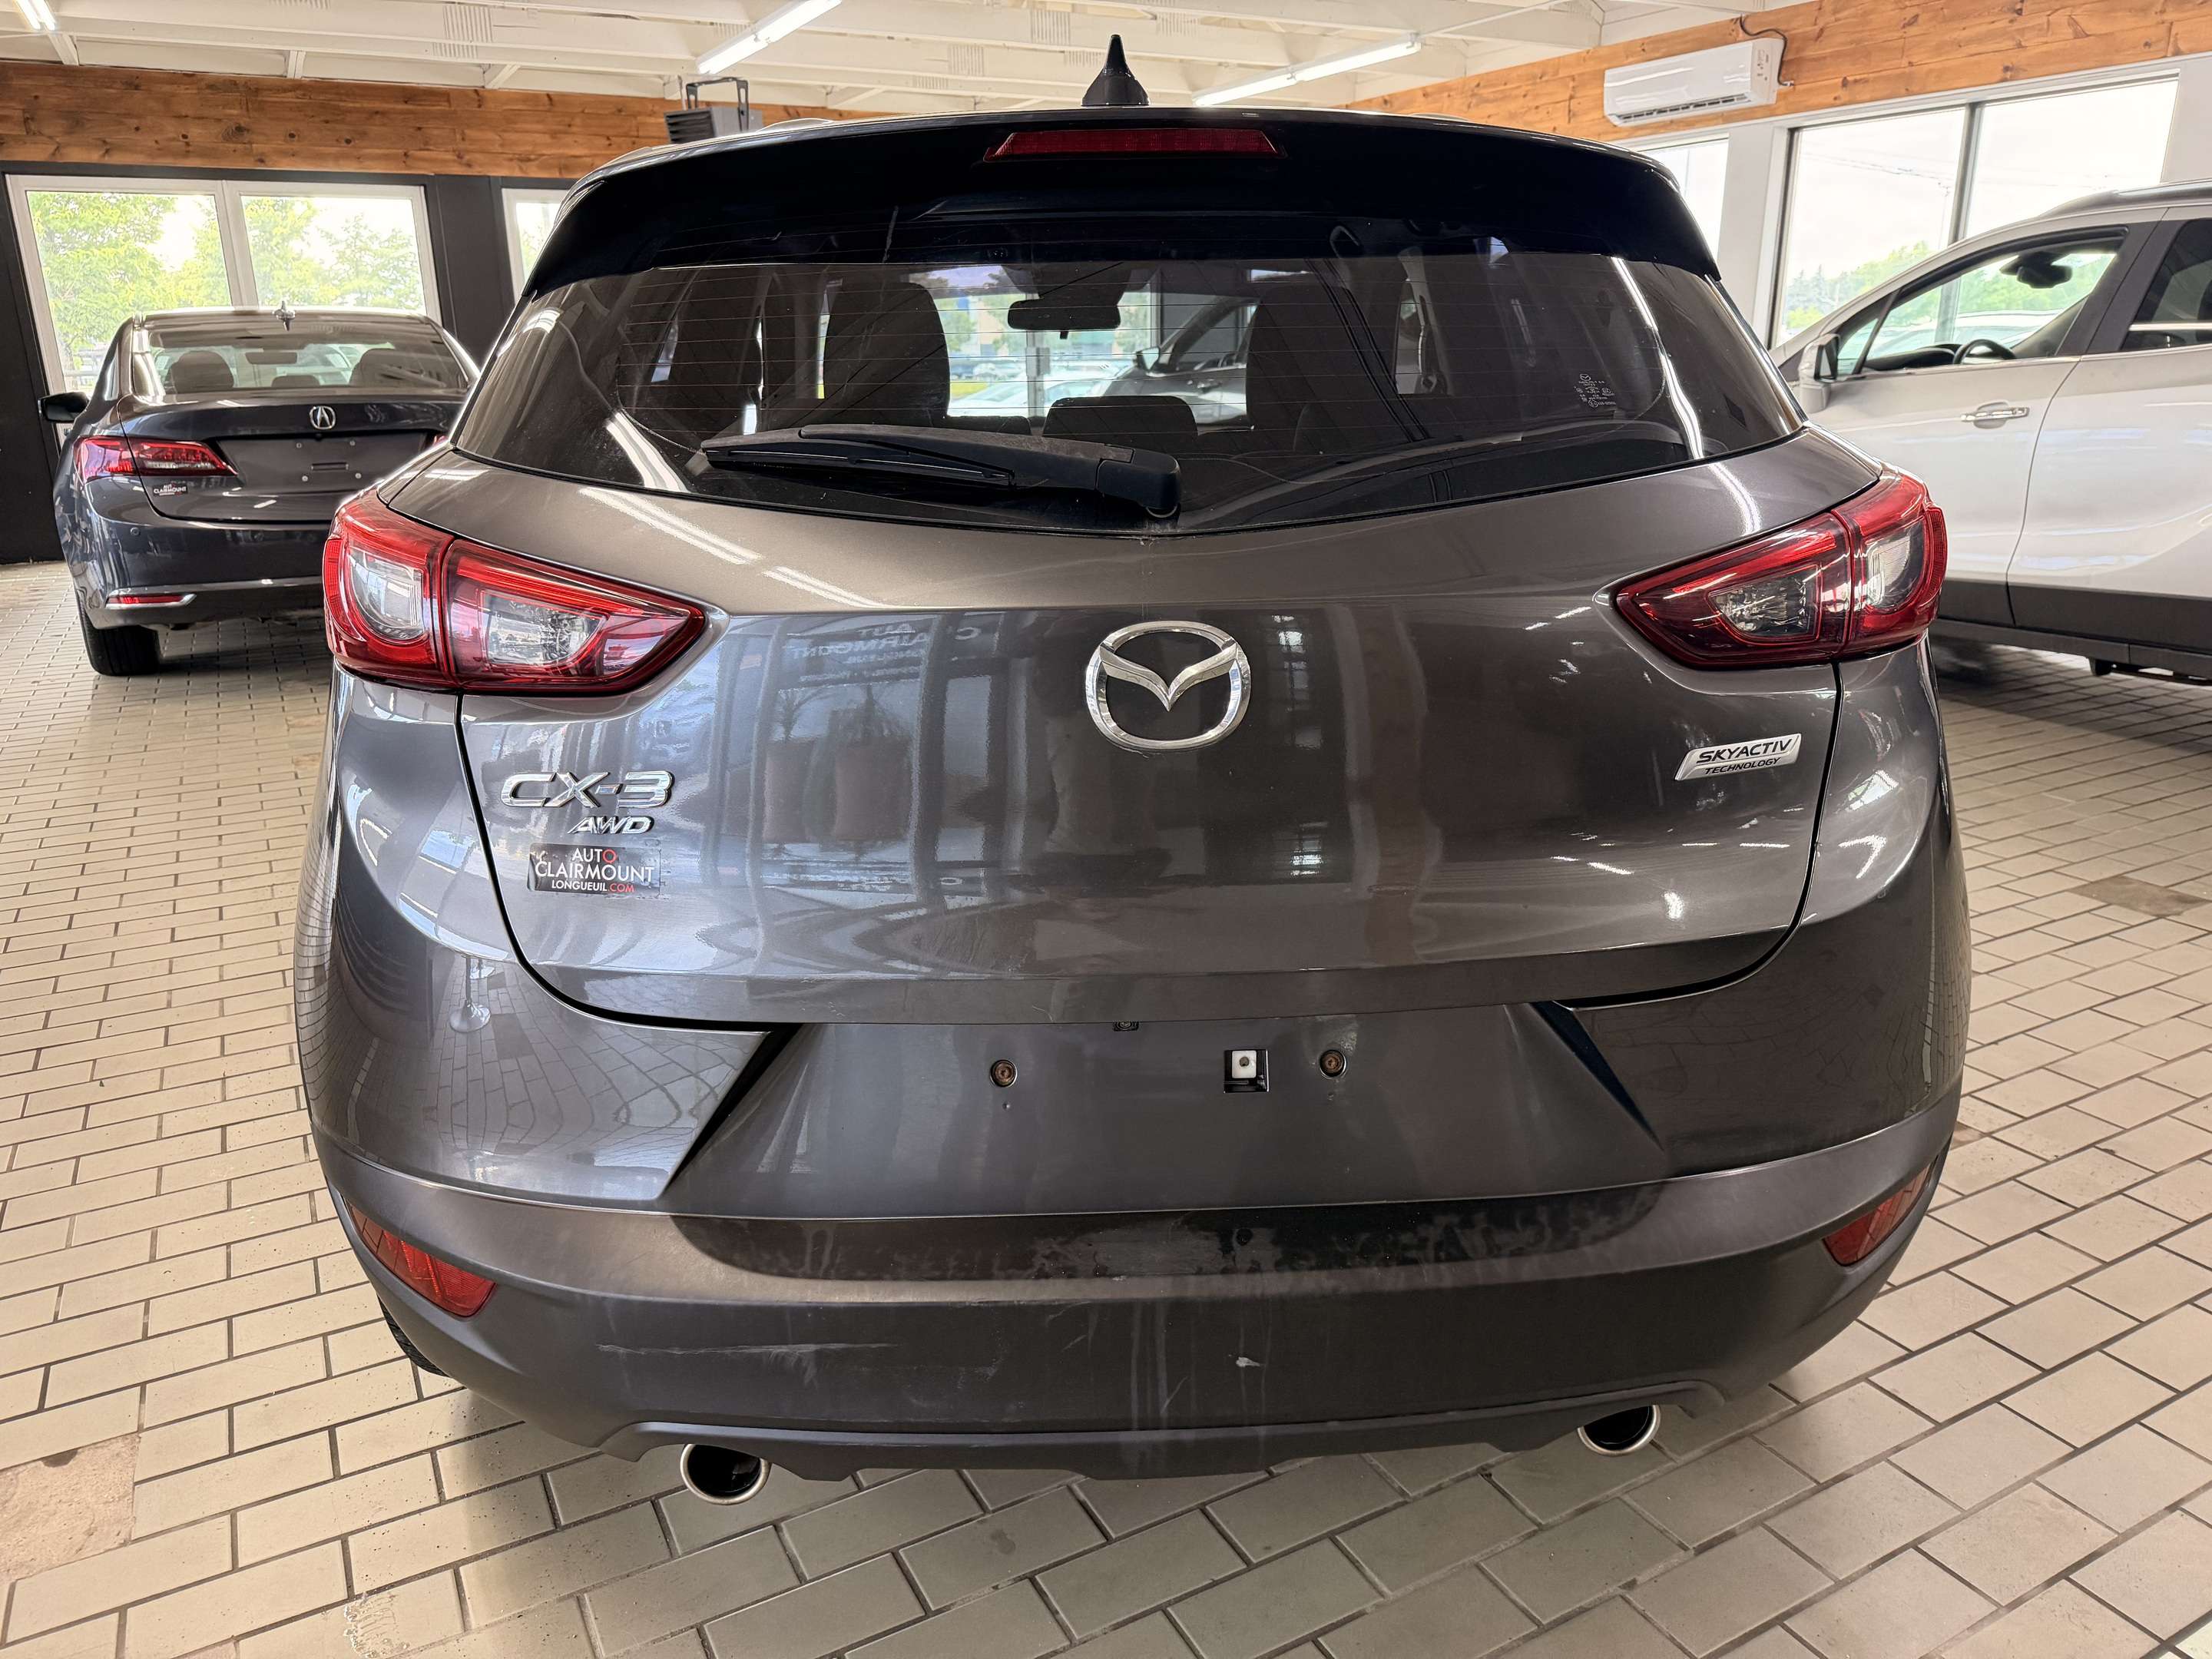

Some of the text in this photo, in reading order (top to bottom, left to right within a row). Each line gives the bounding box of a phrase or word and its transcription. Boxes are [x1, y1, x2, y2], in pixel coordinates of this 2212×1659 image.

[1697, 739, 1793, 764] SKYACTIV
[1705, 757, 1781, 775] TECHNOLOGY
[501, 770, 674, 808] CX-3
[568, 816, 652, 834] AWD
[571, 848, 617, 864] AUTO
[535, 861, 654, 882] CLAIRMOUNT
